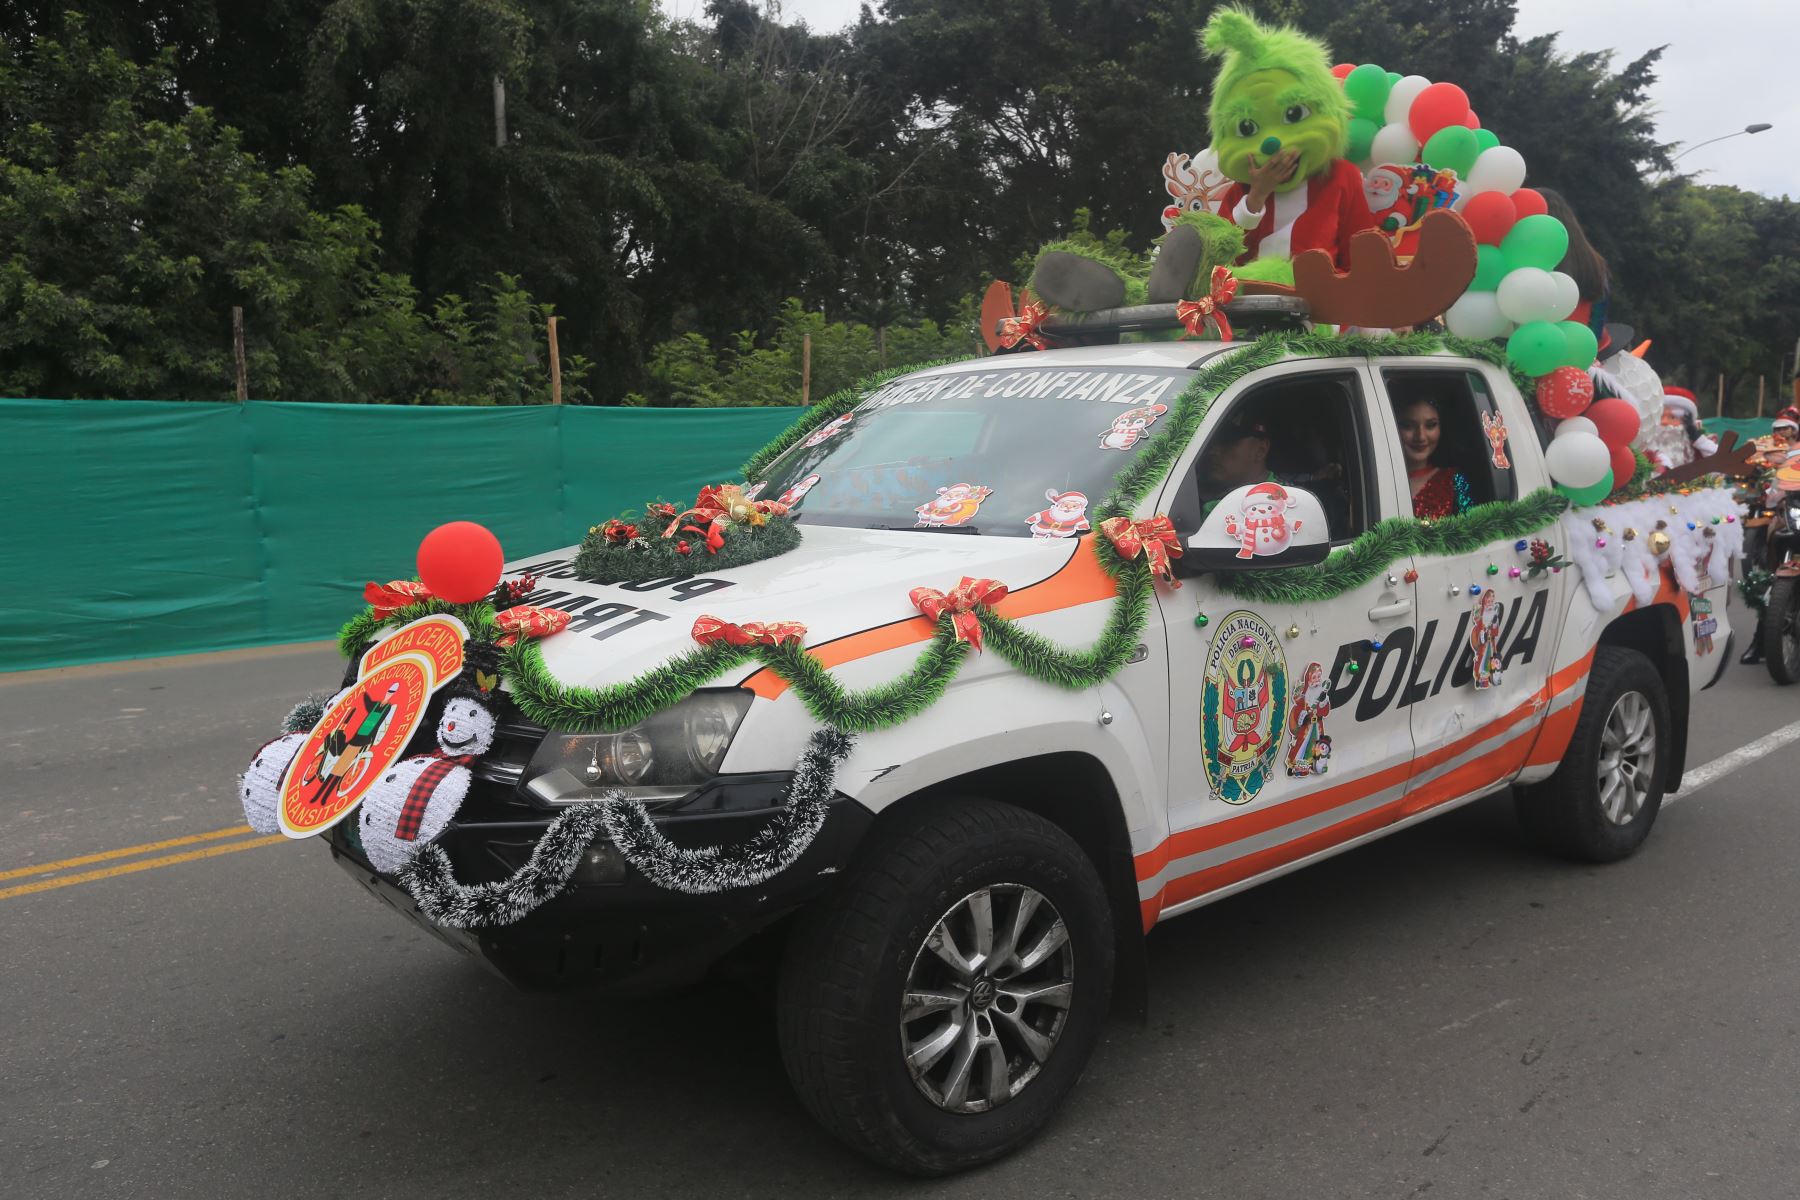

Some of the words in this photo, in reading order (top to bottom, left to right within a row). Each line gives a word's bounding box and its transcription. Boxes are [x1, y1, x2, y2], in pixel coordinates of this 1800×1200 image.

[942, 374, 998, 400] DE
[984, 372, 1175, 405] CONFIANZA
[371, 632, 412, 666] LIMA
[416, 627, 458, 675] CENTRO
[1211, 623, 1236, 669] POLICIA
[1237, 619, 1276, 656] NACIONAL
[370, 664, 418, 688] NACIONAL
[406, 680, 422, 711] DEL
[316, 685, 366, 740] POLICIA
[383, 713, 415, 757] PERU
[1231, 760, 1255, 773] PATRIA
[288, 777, 348, 825] TRANSITO
